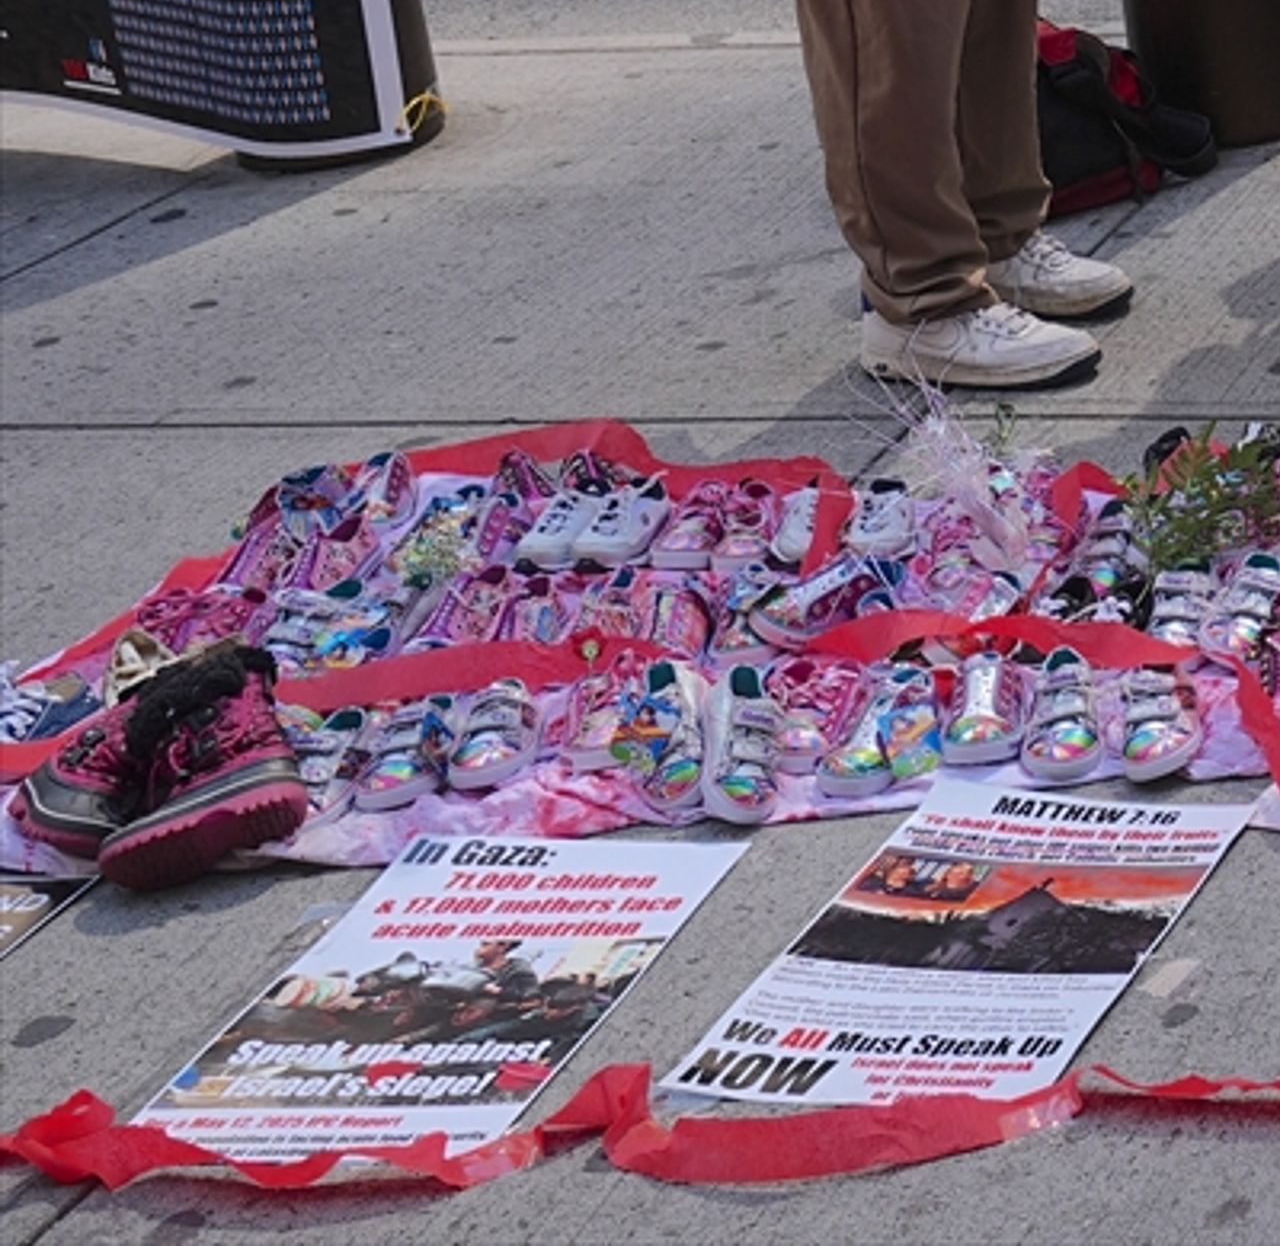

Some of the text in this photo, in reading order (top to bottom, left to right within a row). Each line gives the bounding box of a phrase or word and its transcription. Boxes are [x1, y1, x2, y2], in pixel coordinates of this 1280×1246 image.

[991, 795, 1182, 826] MATTHEW 7:16
[999, 821, 1047, 837] know
[402, 838, 557, 867] In Gaza:
[537, 872, 657, 892] children
[374, 897, 396, 915] &
[494, 896, 613, 915] mothers
[618, 895, 684, 914] face
[371, 919, 642, 939] acute malnutrition
[722, 1018, 1064, 1059] We All Must Speak Up
[228, 1037, 552, 1069] Speak up against
[225, 1072, 367, 1100] Israel's
[679, 1048, 839, 1096] NOW
